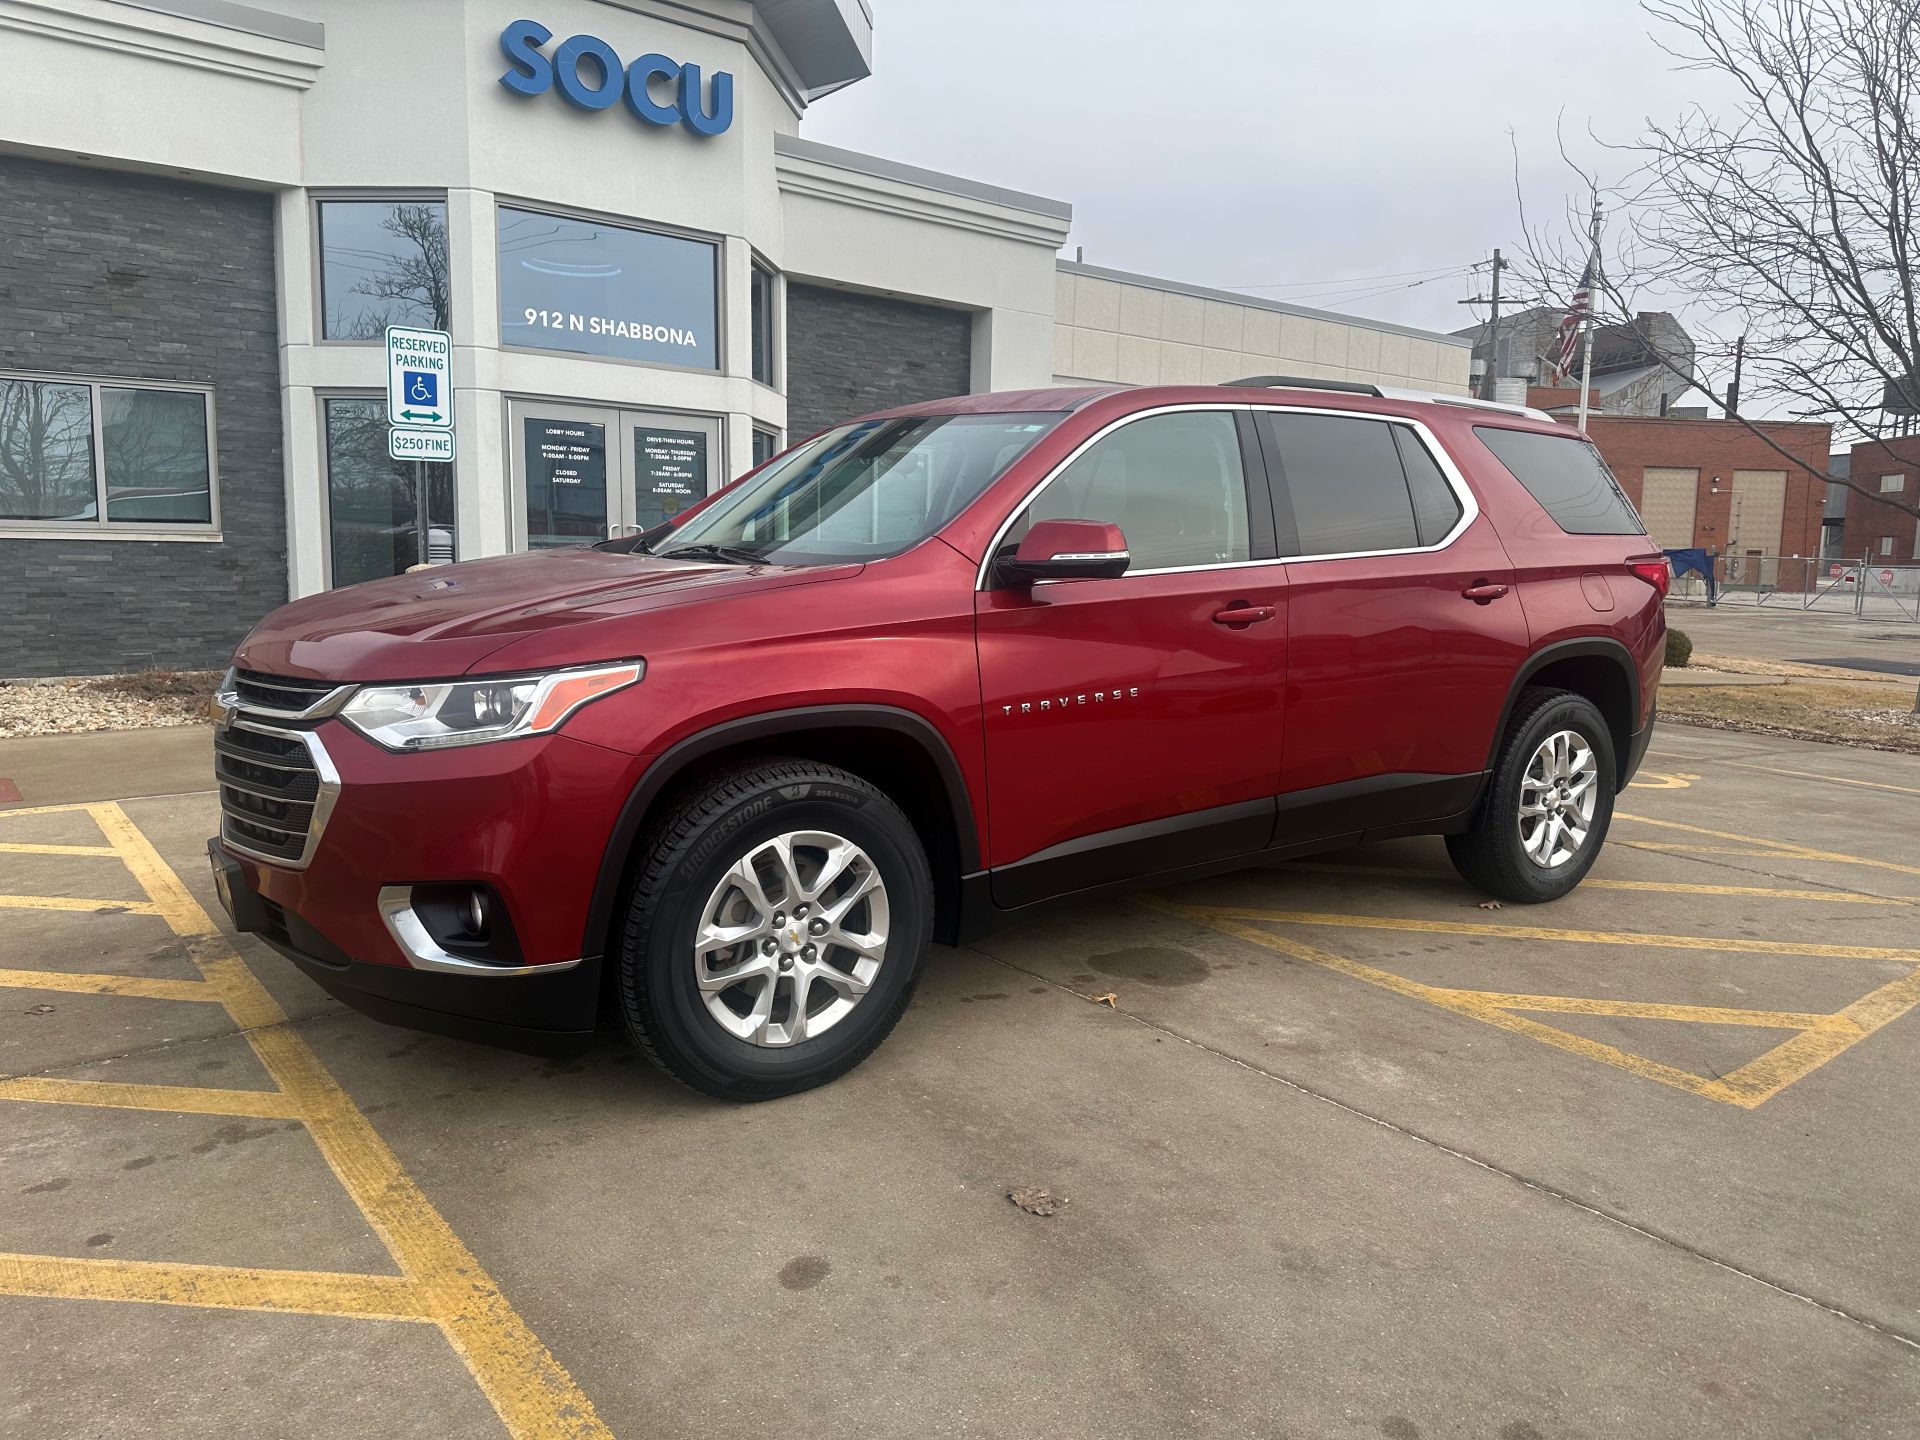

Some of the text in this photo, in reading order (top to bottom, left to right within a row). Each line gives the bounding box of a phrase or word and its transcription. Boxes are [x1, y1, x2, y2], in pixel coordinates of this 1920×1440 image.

[498, 19, 733, 136] SOCU
[525, 308, 697, 347] 912 N SHABBONA
[391, 337, 446, 354] RESERVED
[396, 354, 444, 370] PARKING
[395, 436, 450, 450] $250 FINE
[1003, 687, 1138, 716] TRAVERSE
[679, 796, 774, 881] BRIDGESTONE
